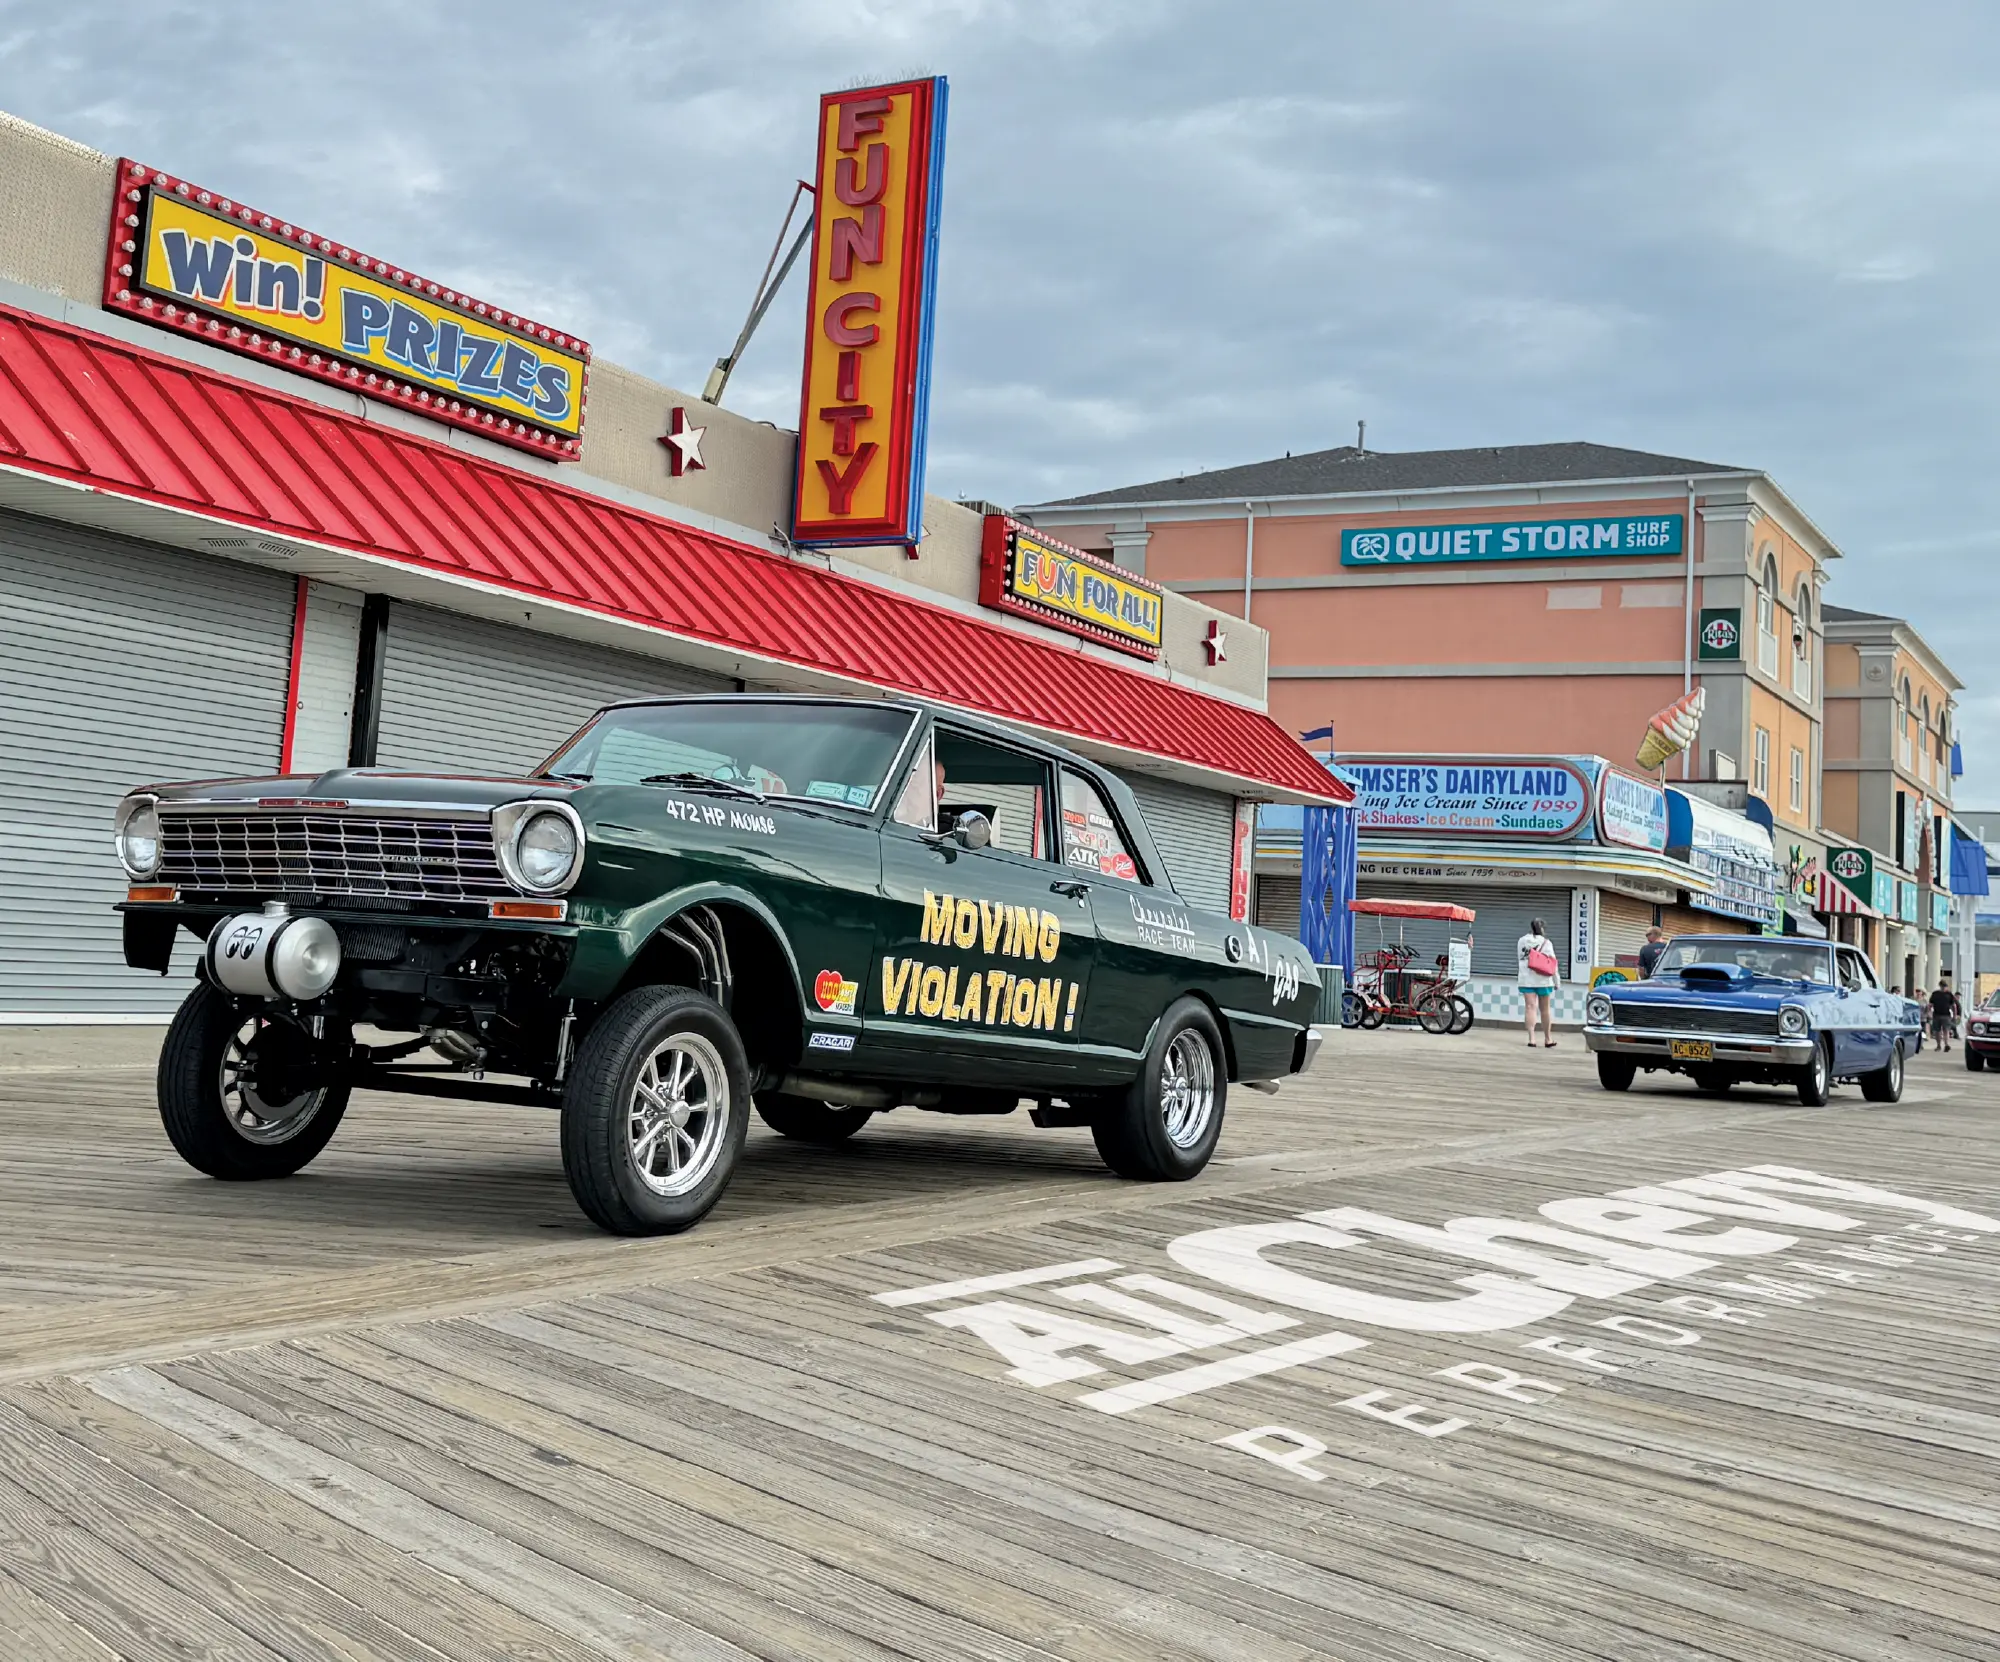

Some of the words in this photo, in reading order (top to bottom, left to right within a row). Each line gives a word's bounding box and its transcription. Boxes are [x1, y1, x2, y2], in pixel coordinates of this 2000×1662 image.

[830, 96, 893, 281] FUN
[340, 288, 571, 420] PRIZES
[815, 291, 881, 515] CITY
[1395, 529, 1493, 561] QUIET
[1501, 523, 1620, 553] STORM
[1626, 521, 1671, 534] SURF
[1626, 534, 1671, 547] SHOP
[1022, 549, 1078, 603] FUN
[1083, 574, 1119, 622] FOR
[1121, 590, 1158, 636] ALL!
[1446, 769, 1567, 797] DAIRYLAND
[666, 799, 701, 823] 472
[701, 805, 726, 827] HP
[1360, 793, 1390, 810] ing
[1424, 795, 1477, 809] Cream
[1482, 796, 1528, 810] Since
[1532, 799, 1577, 812] 1939
[1371, 810, 1420, 825] Shakes
[1426, 812, 1446, 825] Ice
[1449, 813, 1494, 828] Cream
[1501, 813, 1564, 829] Sundaes
[1068, 847, 1099, 866] ATK
[1356, 863, 1376, 874] ING
[1381, 866, 1398, 874] ICE
[1403, 866, 1442, 876] CREAM
[920, 888, 1061, 963] MOVING
[1138, 926, 1165, 946] RACE
[1171, 934, 1195, 955] TEAM
[882, 956, 1080, 1032] VIOLATION!
[812, 1035, 852, 1048] CRAGAR
[1167, 1164, 2000, 1332] Chevy
[1213, 1223, 1980, 1481] PERFORMANCE
